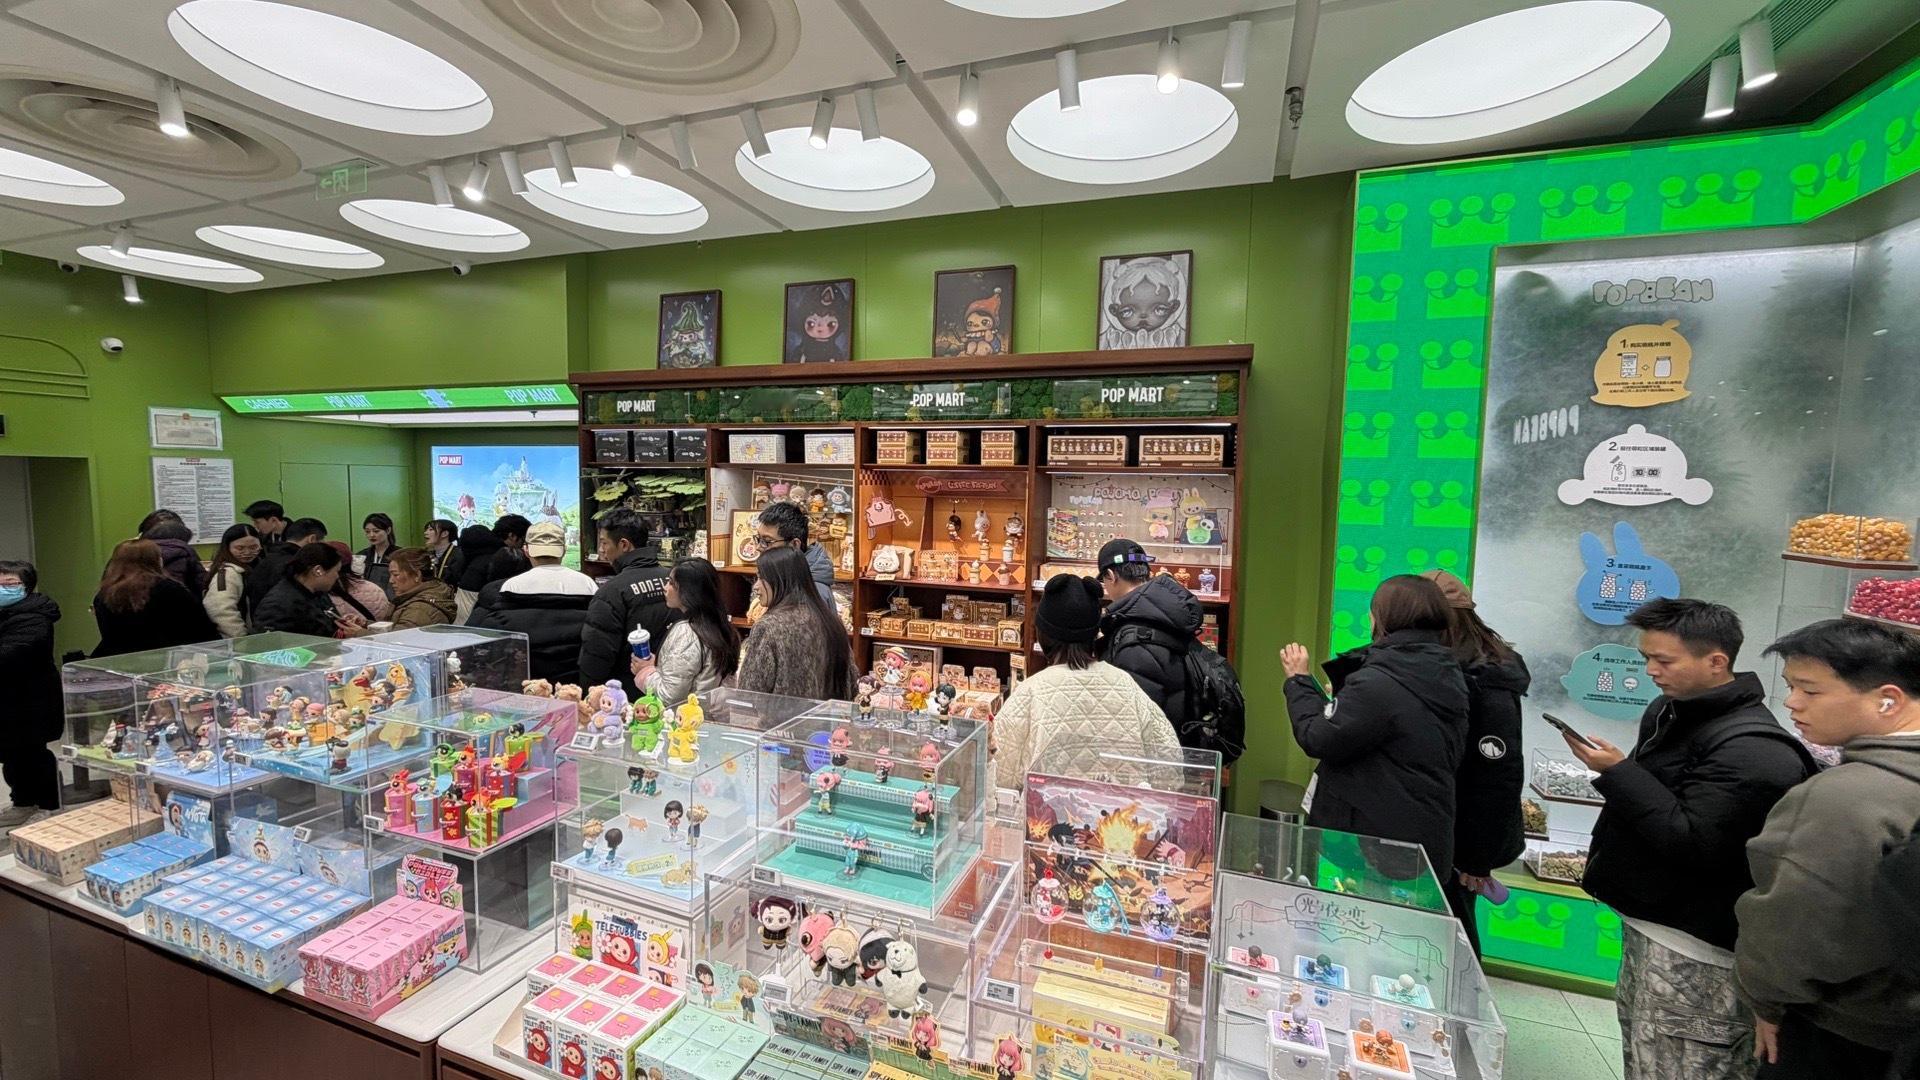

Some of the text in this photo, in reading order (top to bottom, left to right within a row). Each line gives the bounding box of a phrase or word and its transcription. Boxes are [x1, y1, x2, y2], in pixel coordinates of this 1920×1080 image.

[1592, 276, 1714, 306] POPBEAN
[324, 394, 372, 408] POP MART
[505, 387, 561, 403] POP MART
[913, 392, 966, 407] POP MART
[1101, 387, 1164, 403] POP MART
[244, 398, 293, 410] CASHIER
[617, 399, 656, 413] POP MART
[595, 920, 648, 941] TELETUBBIES
